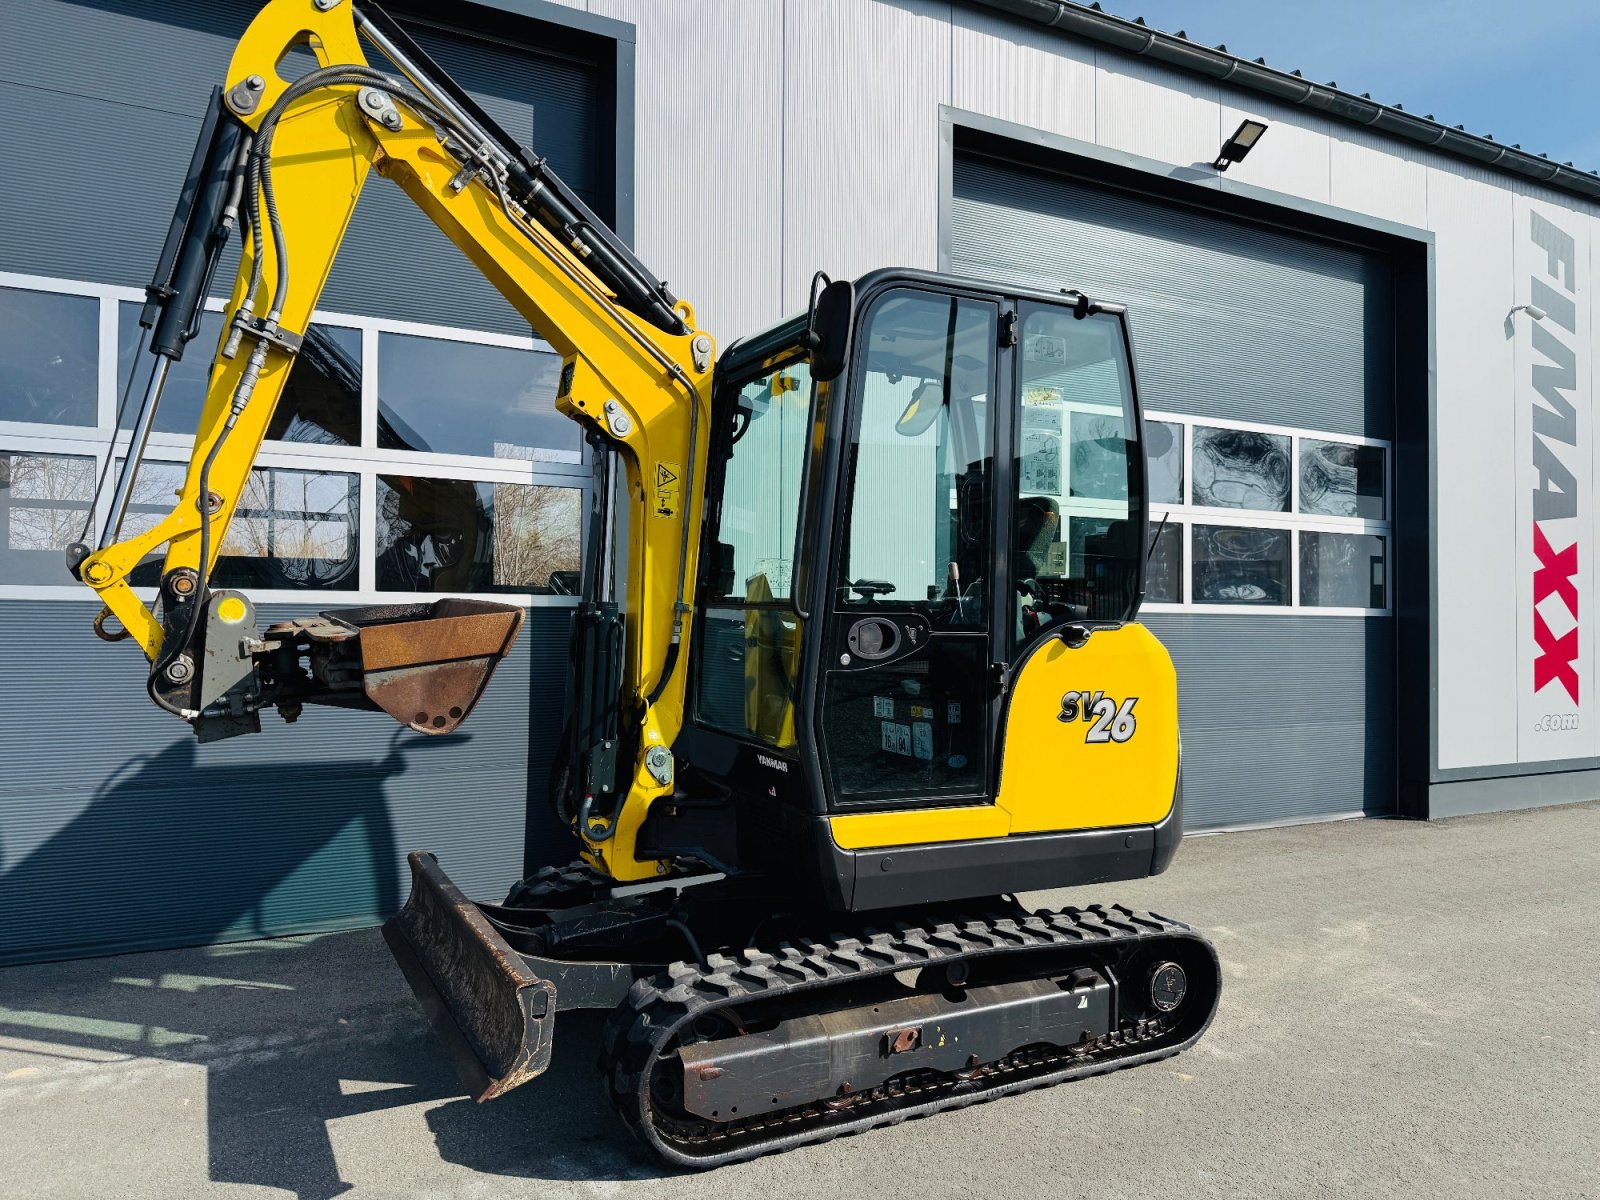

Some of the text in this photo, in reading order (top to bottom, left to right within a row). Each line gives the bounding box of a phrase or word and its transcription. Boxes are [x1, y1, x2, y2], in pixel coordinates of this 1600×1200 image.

[1529, 208, 1580, 708] FIMAXX
[1534, 713, 1580, 732] .com
[756, 753, 788, 773] YANMAR
